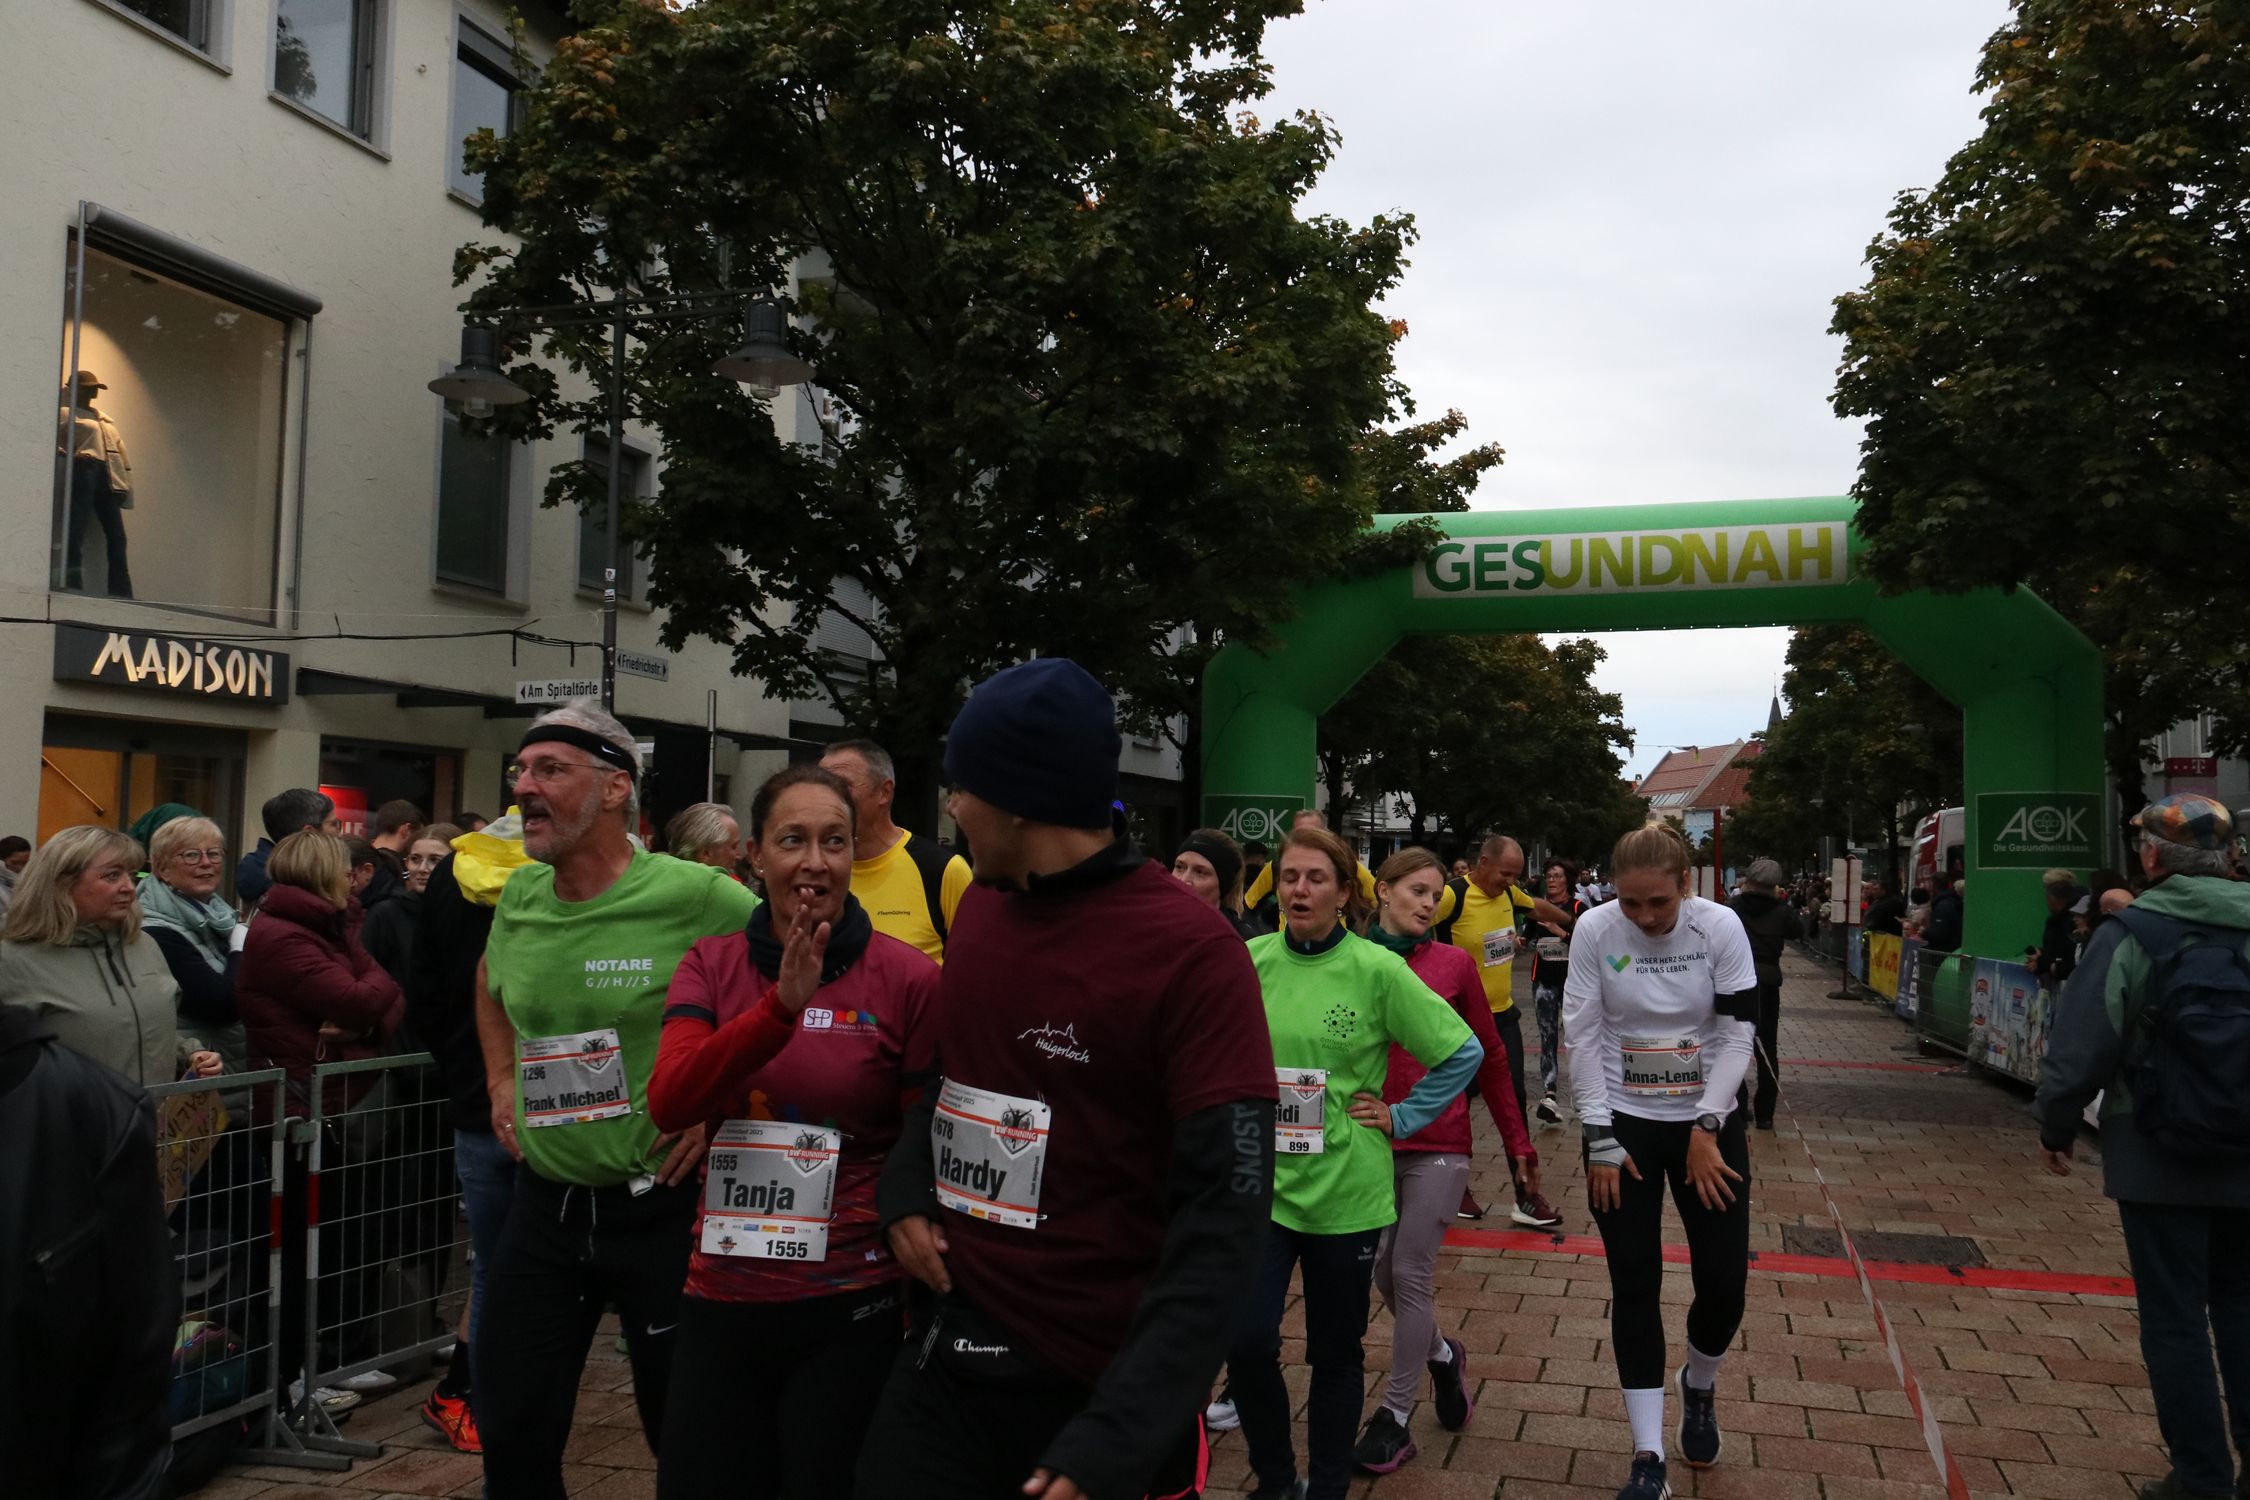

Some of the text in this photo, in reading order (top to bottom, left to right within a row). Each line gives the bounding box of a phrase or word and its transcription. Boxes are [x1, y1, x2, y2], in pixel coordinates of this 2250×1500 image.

[1424, 526, 1833, 592] GESUNDNAH
[622, 654, 662, 675] Friedrichstr.
[527, 682, 598, 699] Am Spitaltörle
[1219, 808, 1290, 840] AOK
[1996, 806, 2089, 842] AOK
[1993, 843, 2007, 852] Die
[584, 959, 653, 972] NOTARE
[1659, 955, 1677, 964] HERZ
[1678, 951, 1708, 963] SCHLÄGT
[1636, 964, 1690, 974] FÜR DAS LEBEN.
[1035, 1037, 1090, 1064] Haigerloch
[1623, 1054, 1634, 1063] 14
[522, 1066, 546, 1081] 1296
[1624, 1069, 1698, 1083] Anna-Lena
[524, 1086, 620, 1112] Frank Michael
[1272, 1104, 1300, 1123] eidi
[933, 1116, 954, 1140] 1678
[1289, 1141, 1310, 1152] 899
[710, 1154, 738, 1171] 1555
[939, 1145, 1007, 1201] Hardy
[723, 1177, 795, 1215] Tanja
[766, 1240, 808, 1258] 1555
[953, 1338, 1009, 1357] Champi
